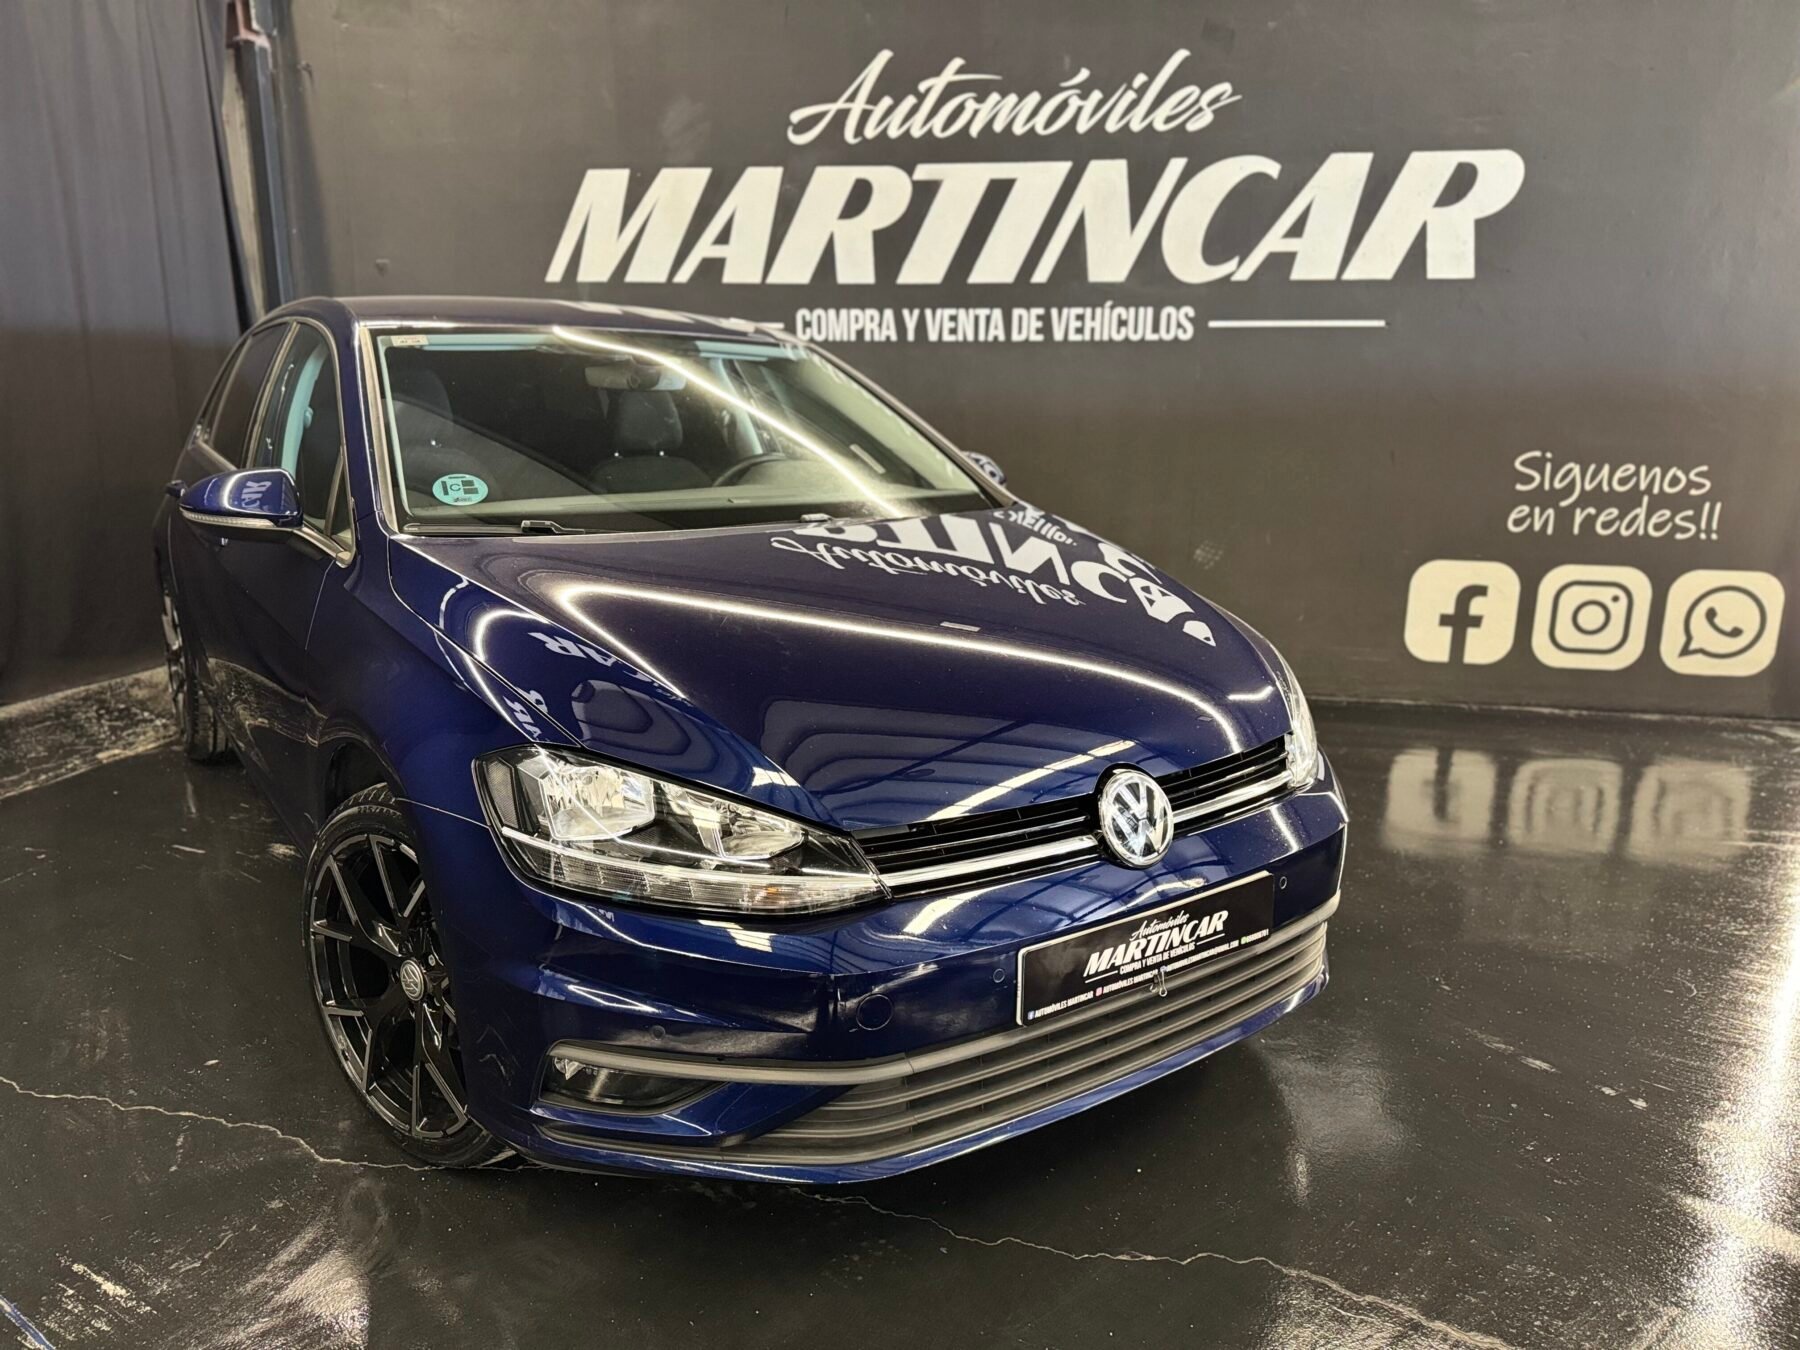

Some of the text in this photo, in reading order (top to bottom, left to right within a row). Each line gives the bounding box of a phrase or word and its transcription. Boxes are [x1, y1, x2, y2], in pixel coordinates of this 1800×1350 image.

[787, 48, 1242, 145] Automóviles
[545, 149, 1525, 284] MARTINCAR
[795, 300, 1196, 343] COMPRA Y VENTA DE VEHÍCULOS
[1514, 450, 1712, 507] Siguenos
[1507, 494, 1722, 540] en redes!!
[1083, 910, 1229, 977] MARTINCAR
[1130, 910, 1190, 942] Automóviles
[1119, 960, 1142, 975] COMPRA
[1146, 954, 1163, 966] VENTA
